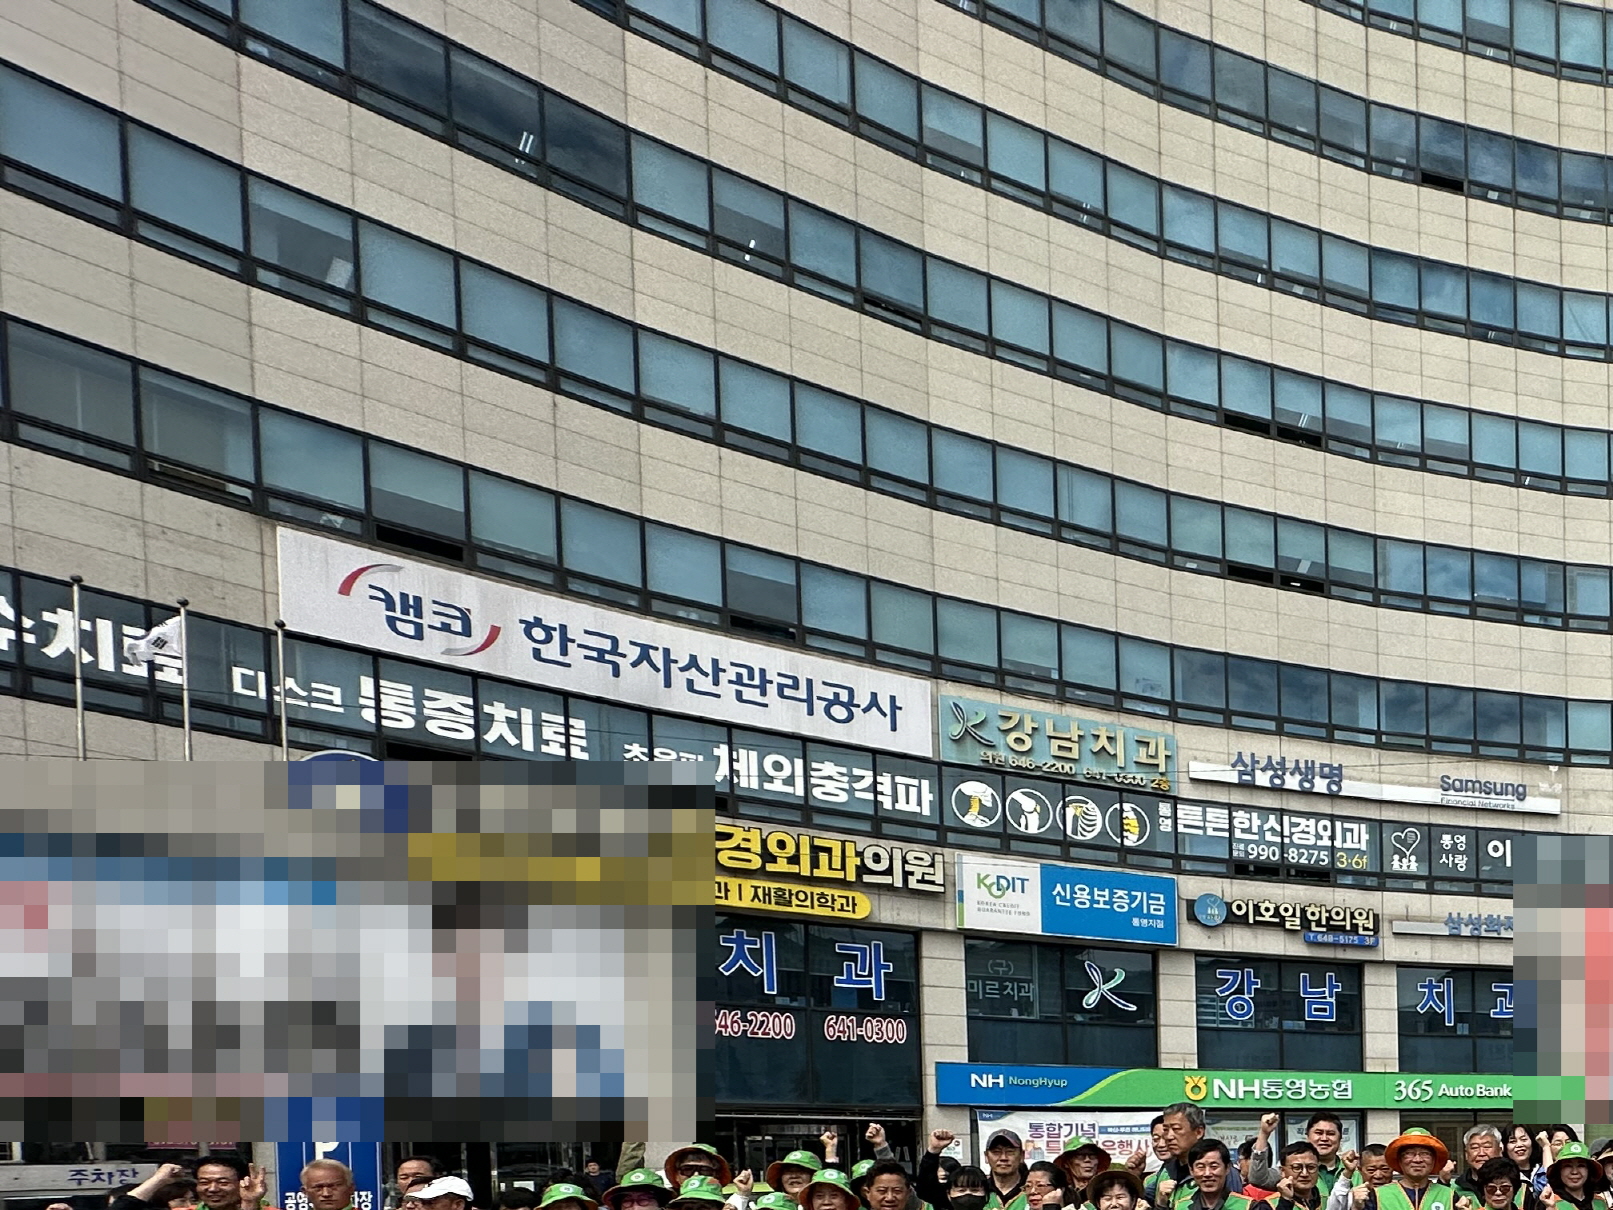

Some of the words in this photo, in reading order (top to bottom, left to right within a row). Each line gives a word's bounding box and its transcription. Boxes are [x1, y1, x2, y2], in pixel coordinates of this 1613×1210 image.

[369, 584, 472, 641] 캠코
[519, 616, 902, 732] 한국자산관리공사
[232, 666, 344, 714] 디스크
[358, 675, 590, 761] 통증치료
[998, 709, 1172, 773] 강남치과
[1008, 754, 1076, 775] 646-2200
[1231, 751, 1344, 795] 삼성생명
[713, 744, 934, 816] 체외충격파
[1440, 775, 1527, 800] Samsung
[1441, 797, 1477, 807] Financial
[1478, 800, 1515, 810] Networks
[1440, 833, 1466, 851] 통영
[1440, 854, 1468, 872] 사랑
[977, 873, 1029, 900] KODIT
[749, 884, 858, 914] 재활의학과
[1052, 883, 1166, 916] 신용보증기금
[1131, 917, 1165, 929] 통영지점
[987, 959, 1014, 976] (구)
[968, 980, 1034, 1001] 미르치과
[715, 1010, 795, 1040] 46-2200
[824, 1016, 907, 1044] 641-0300
[971, 1072, 1004, 1089] NH
[1009, 1075, 1068, 1090] NongHyup
[1212, 1078, 1353, 1101] NH통영농협
[1394, 1079, 1433, 1102] 365
[1438, 1082, 1474, 1098] Auto
[1476, 1083, 1513, 1099] Bank
[1028, 1121, 1098, 1140] 통합기념
[67, 1167, 139, 1186] 주차장
